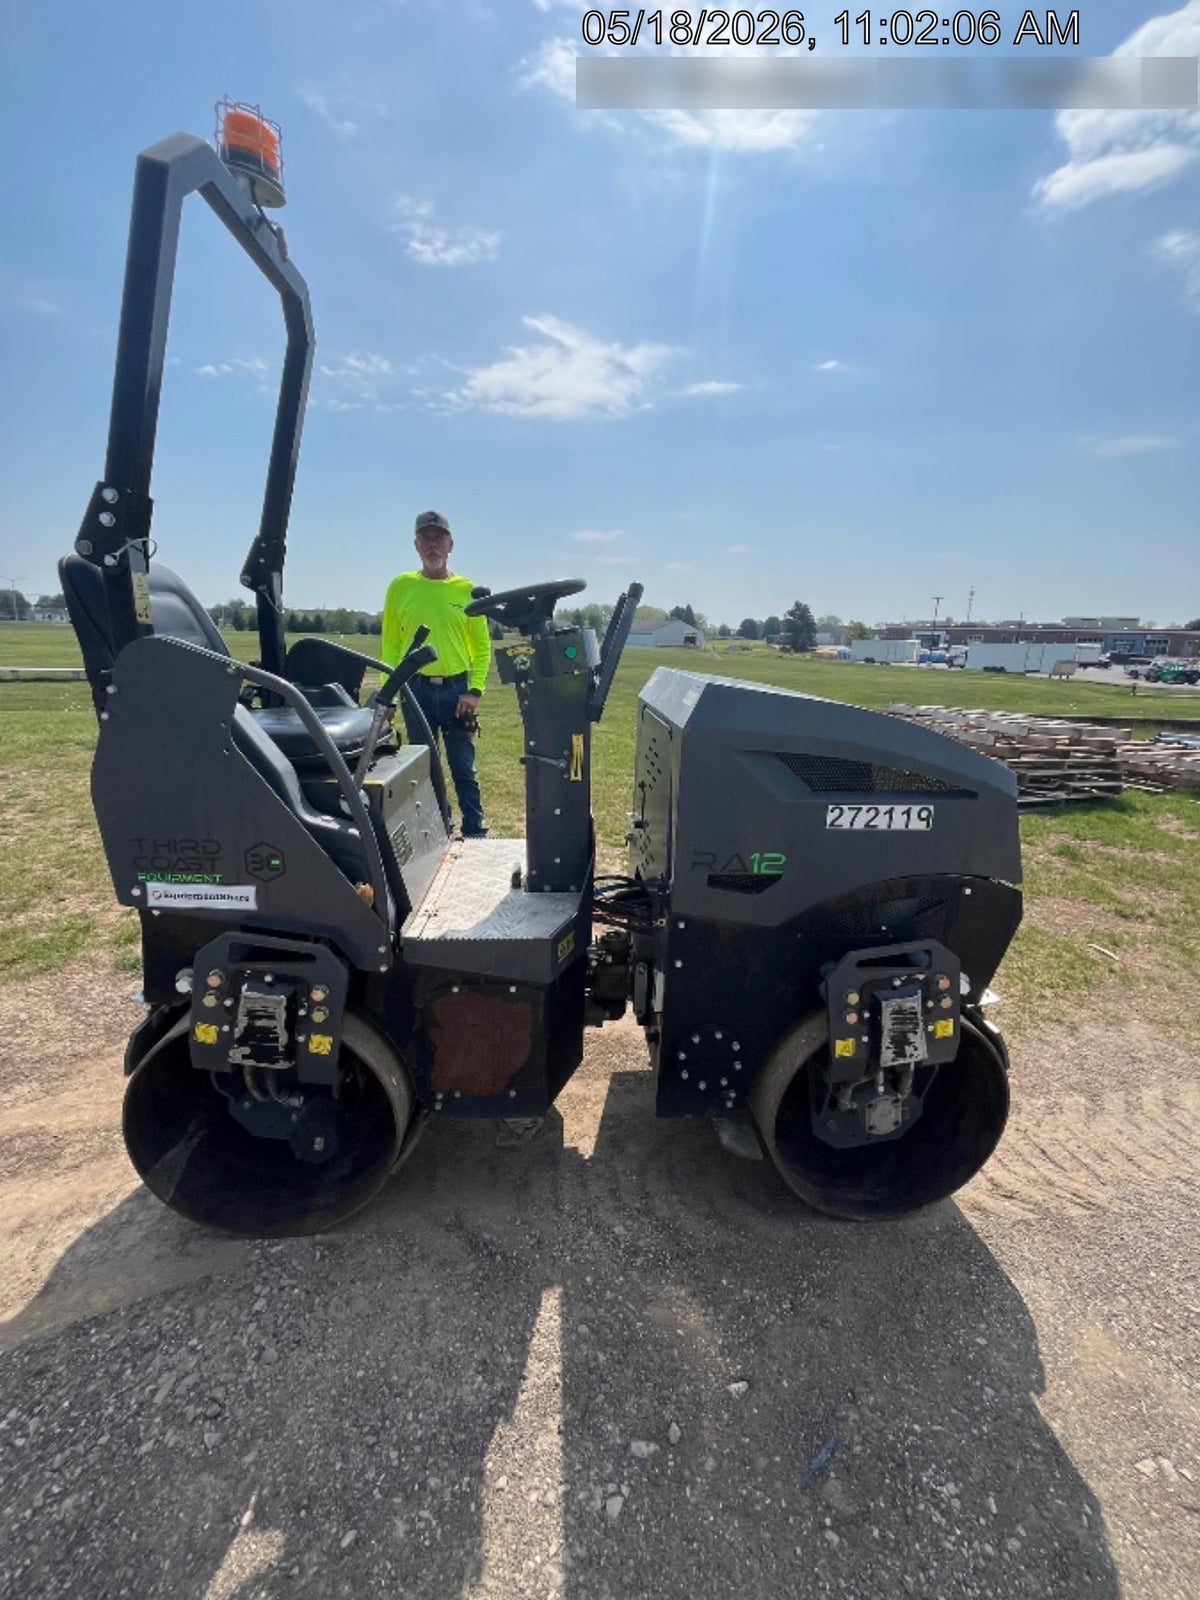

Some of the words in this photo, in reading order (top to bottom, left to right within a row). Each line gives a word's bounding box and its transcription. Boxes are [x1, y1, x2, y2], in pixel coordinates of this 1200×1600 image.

[828, 806, 933, 829] 272119
[131, 838, 222, 855] THIRD
[133, 856, 222, 872] COAST
[690, 852, 786, 875] RA12
[137, 872, 222, 883] EQUIPMENT
